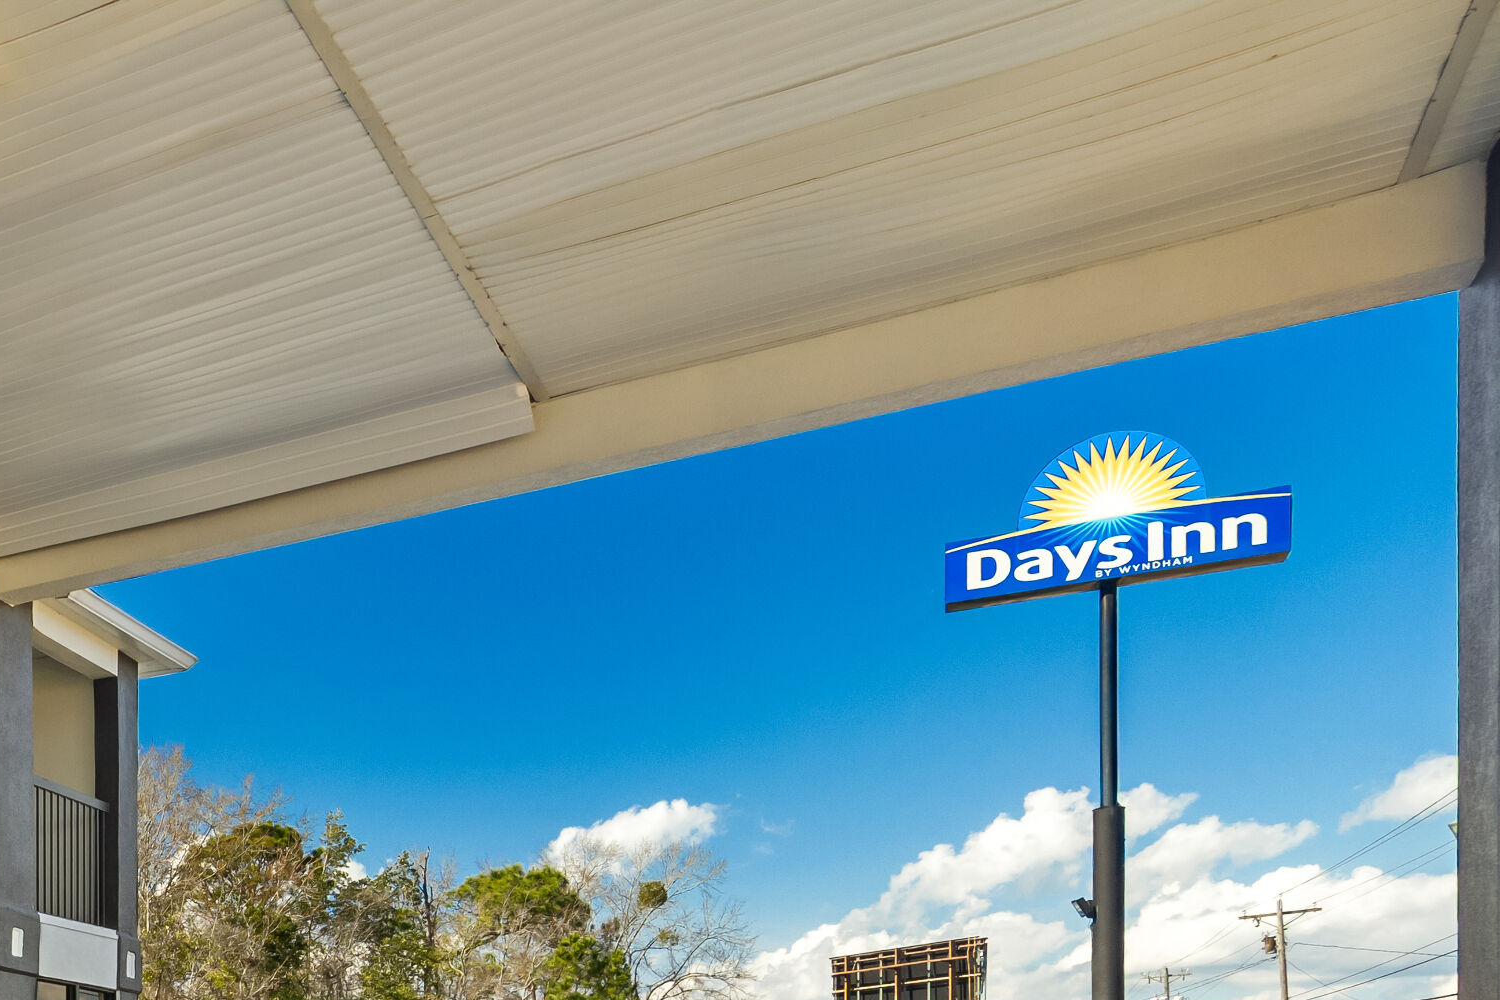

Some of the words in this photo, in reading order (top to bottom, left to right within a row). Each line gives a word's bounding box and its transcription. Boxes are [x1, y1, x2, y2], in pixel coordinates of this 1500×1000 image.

[966, 534, 1132, 591] Days
[1148, 512, 1268, 562] Inn
[1095, 568, 1112, 578] BY
[1119, 555, 1193, 575] WYNDHAM
